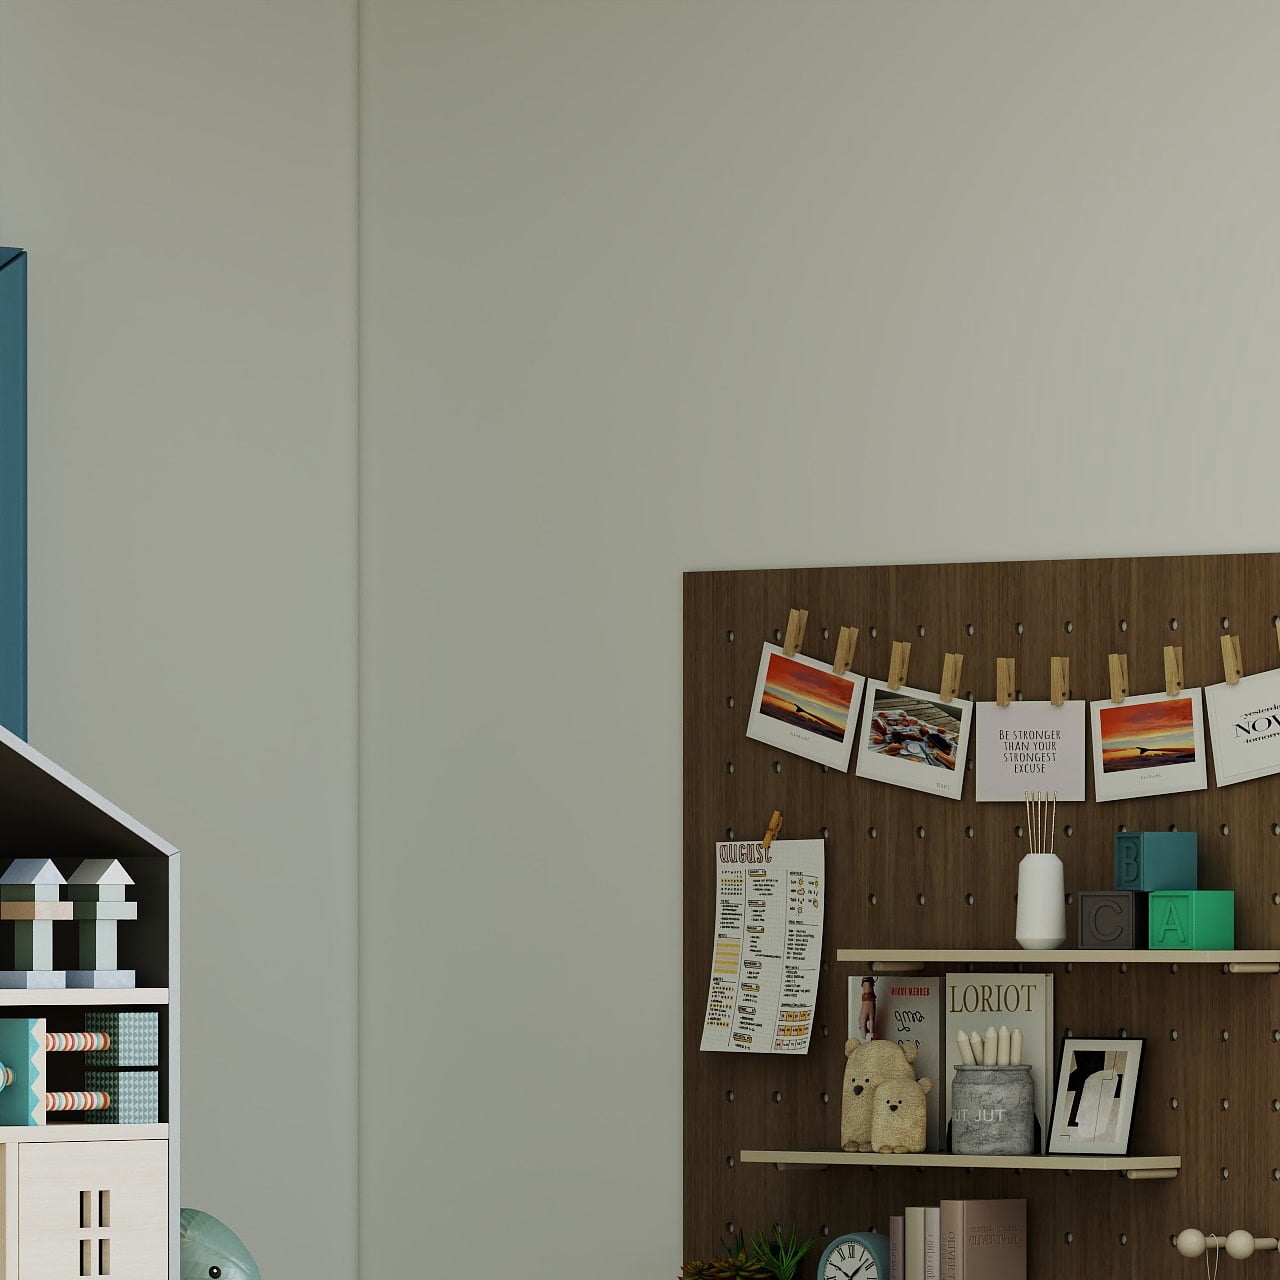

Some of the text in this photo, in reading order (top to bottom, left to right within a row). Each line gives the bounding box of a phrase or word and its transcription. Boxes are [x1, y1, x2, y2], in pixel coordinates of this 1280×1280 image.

[1121, 840, 1139, 882] B
[1089, 900, 1124, 942] C
[1158, 900, 1186, 943] A
[950, 984, 1037, 1013] LORIOT
[974, 1109, 1007, 1122] JUT
[948, 1231, 956, 1271] OLIVER
